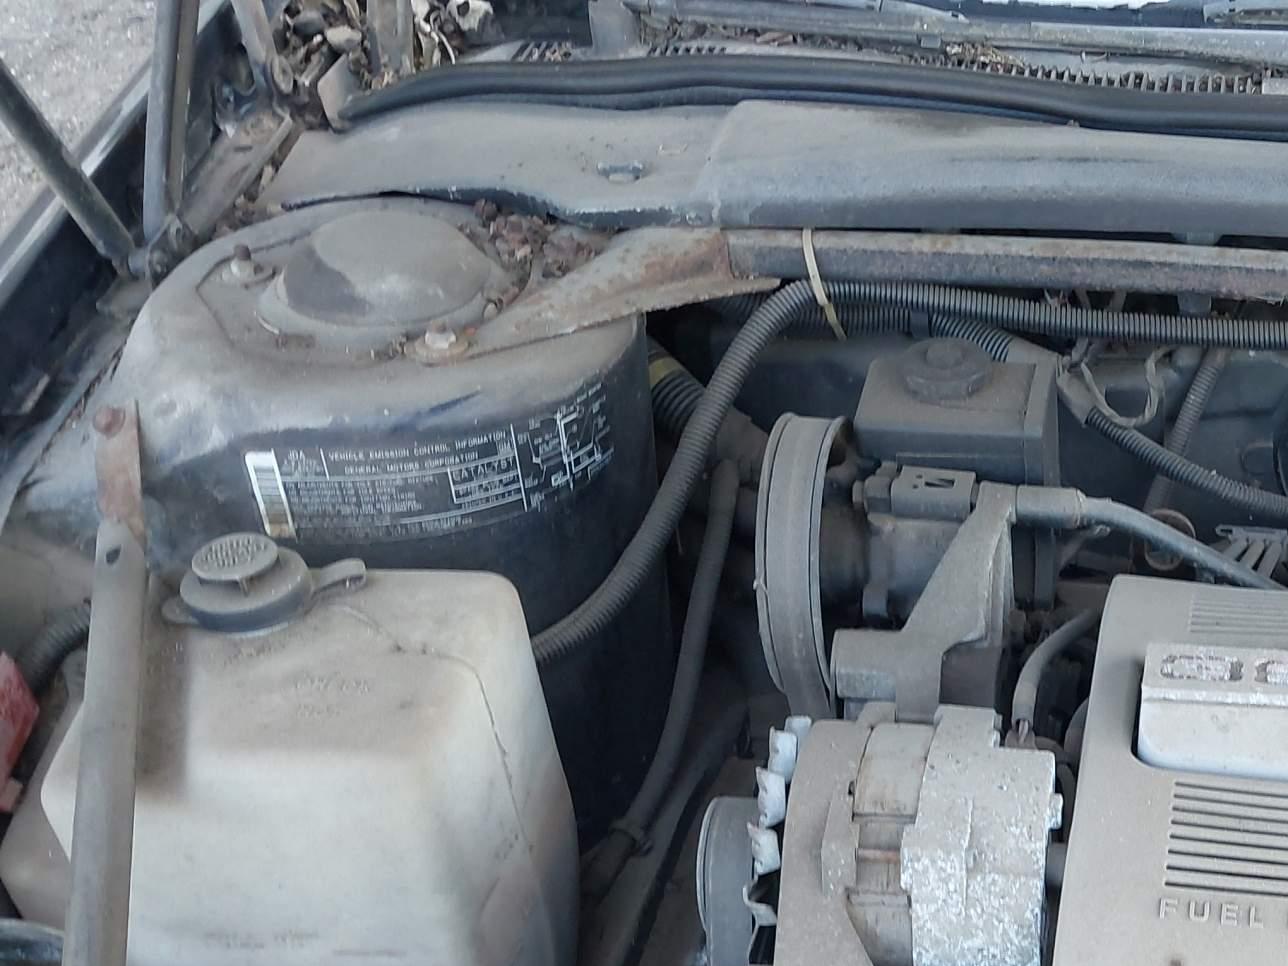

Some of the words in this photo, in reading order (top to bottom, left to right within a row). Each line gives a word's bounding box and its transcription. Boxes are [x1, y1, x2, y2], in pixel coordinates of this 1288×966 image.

[369, 448, 410, 461] EMISSION
[414, 444, 448, 457] CONTROL
[455, 430, 506, 450] INFORMATION
[344, 463, 380, 475] GENERAL
[386, 459, 421, 472] MOTORS
[424, 451, 479, 468] CORPORATION
[452, 457, 514, 481] CATALYST
[1159, 898, 1264, 929] FUEL
